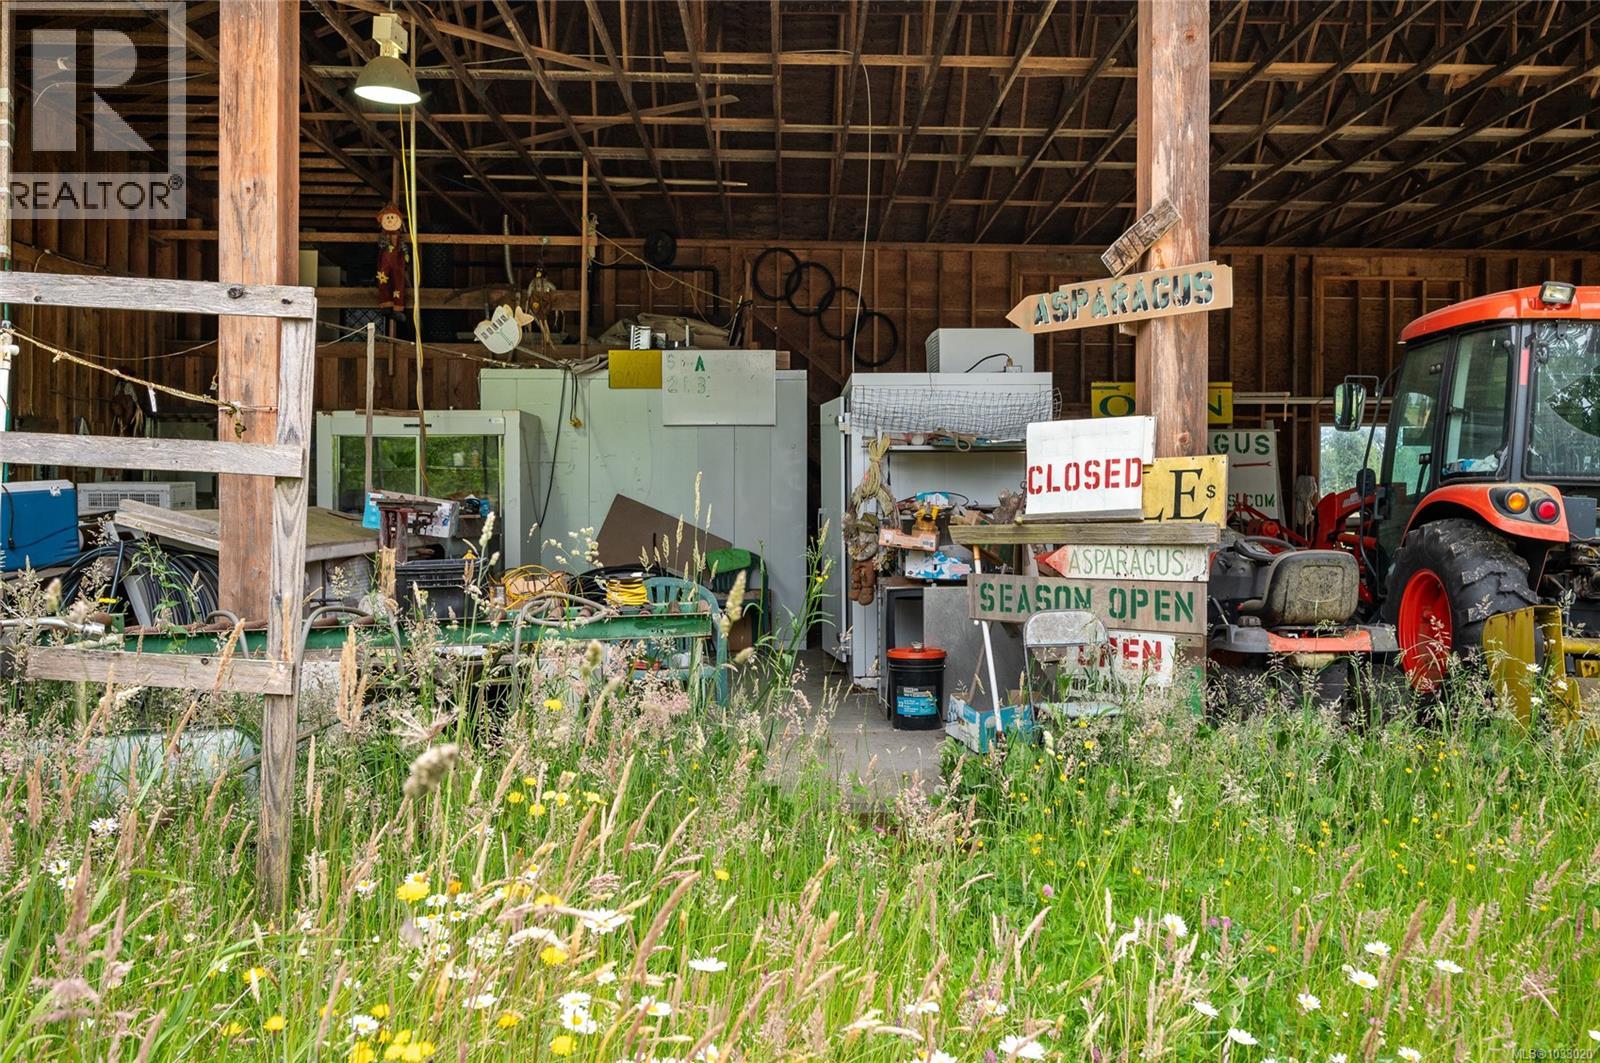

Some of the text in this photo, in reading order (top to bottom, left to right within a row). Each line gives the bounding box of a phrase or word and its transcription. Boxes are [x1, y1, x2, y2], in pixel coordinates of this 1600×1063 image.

[1034, 271, 1214, 326] ASPARAGUS
[1208, 433, 1270, 455] GUS
[1028, 457, 1142, 495] CLOSED
[1068, 548, 1185, 576] ASPARAGUS
[979, 582, 1194, 623] SEASON OPEN
